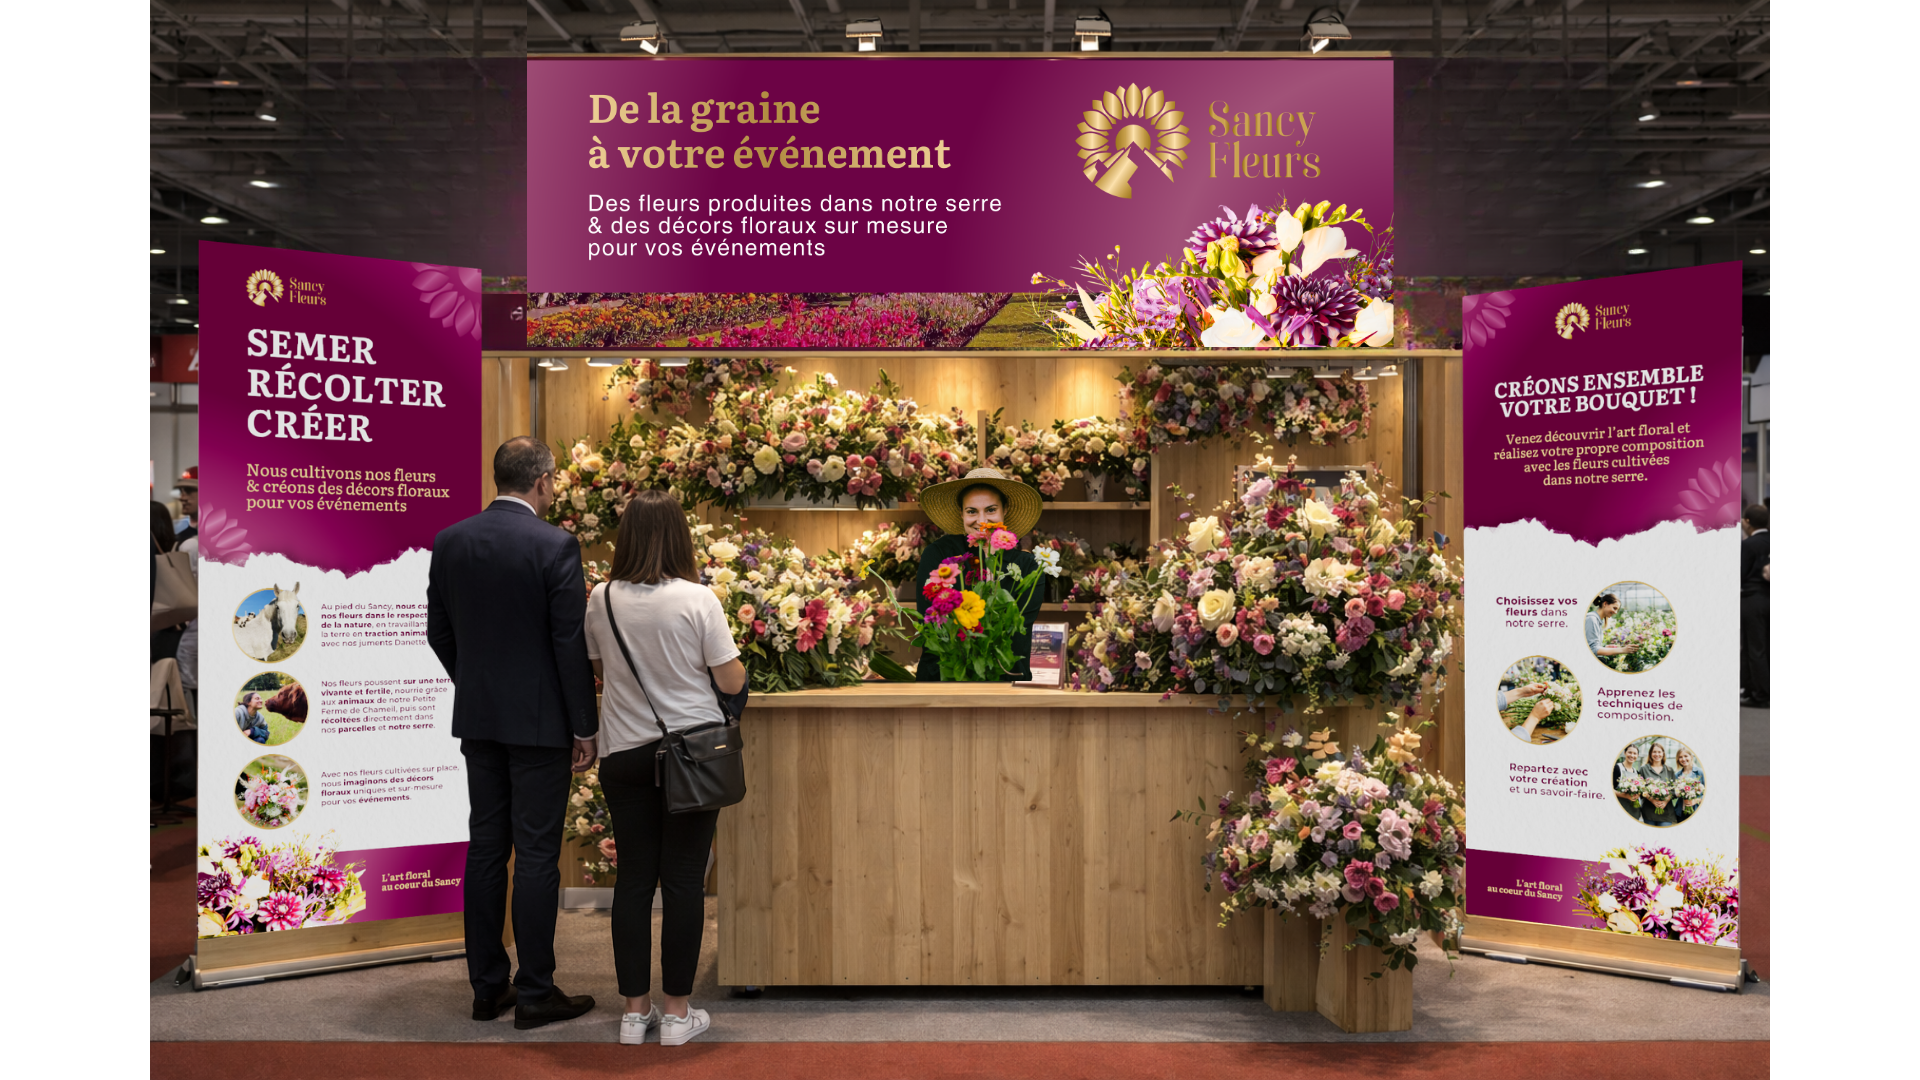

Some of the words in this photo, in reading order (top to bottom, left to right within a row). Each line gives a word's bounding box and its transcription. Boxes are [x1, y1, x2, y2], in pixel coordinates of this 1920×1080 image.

[589, 94, 639, 124] De
[647, 92, 682, 124] la
[690, 91, 820, 133] graine
[1209, 100, 1316, 145] Sancy
[588, 135, 609, 168] à
[618, 140, 725, 168] votre
[733, 135, 951, 168] événement
[1209, 142, 1321, 179] Fleurs
[588, 194, 630, 212] Des
[638, 194, 700, 212] fleurs
[708, 194, 812, 216] produites
[820, 194, 873, 212] dans
[882, 196, 938, 212] notre
[945, 198, 1002, 212] serre
[588, 216, 603, 234] &
[611, 216, 650, 234] des
[658, 216, 734, 234] décors
[741, 216, 817, 234] floraux
[824, 220, 860, 234] sur
[867, 220, 948, 234] mesure
[588, 242, 638, 260] pour
[644, 242, 683, 256] vos
[691, 238, 825, 256] événements
[290, 277, 324, 294] Sancy
[290, 290, 326, 306] Fleurs
[1595, 304, 1630, 319] Sancy
[1595, 316, 1631, 330] Fleurs
[248, 328, 376, 364] SEMER
[248, 362, 446, 408] RÉCOLTER
[1494, 376, 1579, 398] CRÉONS
[1583, 364, 1704, 391] ENSEMBLE
[1500, 397, 1571, 418] VOTRE
[1575, 387, 1685, 412] BOUQUET
[1690, 386, 1696, 404] !
[248, 404, 372, 442] CRÉER
[1506, 433, 1542, 445] Venez
[1544, 428, 1605, 443] découvrir
[1638, 422, 1674, 436] floral
[1677, 423, 1690, 434] et
[1494, 448, 1539, 460] réalisez
[1541, 446, 1573, 458] votre
[1576, 443, 1619, 458] propre
[1621, 437, 1704, 455] composition
[1524, 462, 1551, 473] avec
[1554, 459, 1570, 472] les
[1572, 458, 1609, 471] fleurs
[1611, 454, 1670, 468] cultivées
[246, 464, 287, 478] Nous
[290, 465, 362, 480] cultivons
[365, 470, 391, 482] nos
[394, 468, 436, 482] fleurs
[1543, 473, 1572, 486] dans
[1574, 472, 1609, 484] notre
[1611, 471, 1648, 483] serre.
[246, 480, 260, 492] &
[263, 481, 314, 494] créons
[318, 482, 342, 495] des
[346, 482, 394, 496] décors
[397, 483, 450, 498] floraux
[246, 498, 284, 512] pour
[287, 499, 314, 510] vos
[317, 496, 406, 512] événements
[335, 603, 352, 611] pied
[368, 603, 393, 611] Sancy,
[1496, 596, 1554, 605] Choisissez
[1506, 608, 1537, 616] fleurs
[1541, 608, 1567, 616] dans
[1597, 687, 1654, 698] Apprenez
[1659, 689, 1675, 698] les
[1597, 699, 1664, 710] techniques
[1668, 701, 1683, 710] de
[363, 714, 412, 722] directement
[1597, 711, 1674, 721] composition.
[338, 725, 376, 734] parcelles
[1510, 763, 1559, 774] Repartez
[1562, 768, 1588, 776] avec
[344, 777, 388, 786] imaginons
[1509, 775, 1538, 783] votre
[1541, 776, 1588, 787] création
[354, 787, 386, 795] uniques
[398, 783, 443, 792] sur-mesure
[1540, 788, 1605, 800] savoir-faire.
[359, 794, 412, 803] événements.
[406, 870, 430, 880] floral
[422, 879, 433, 888] du
[435, 878, 461, 887] Sancy
[1539, 881, 1563, 891] floral
[1499, 887, 1523, 895] coeur
[1524, 889, 1535, 897] du
[1537, 891, 1563, 902] Sancy
